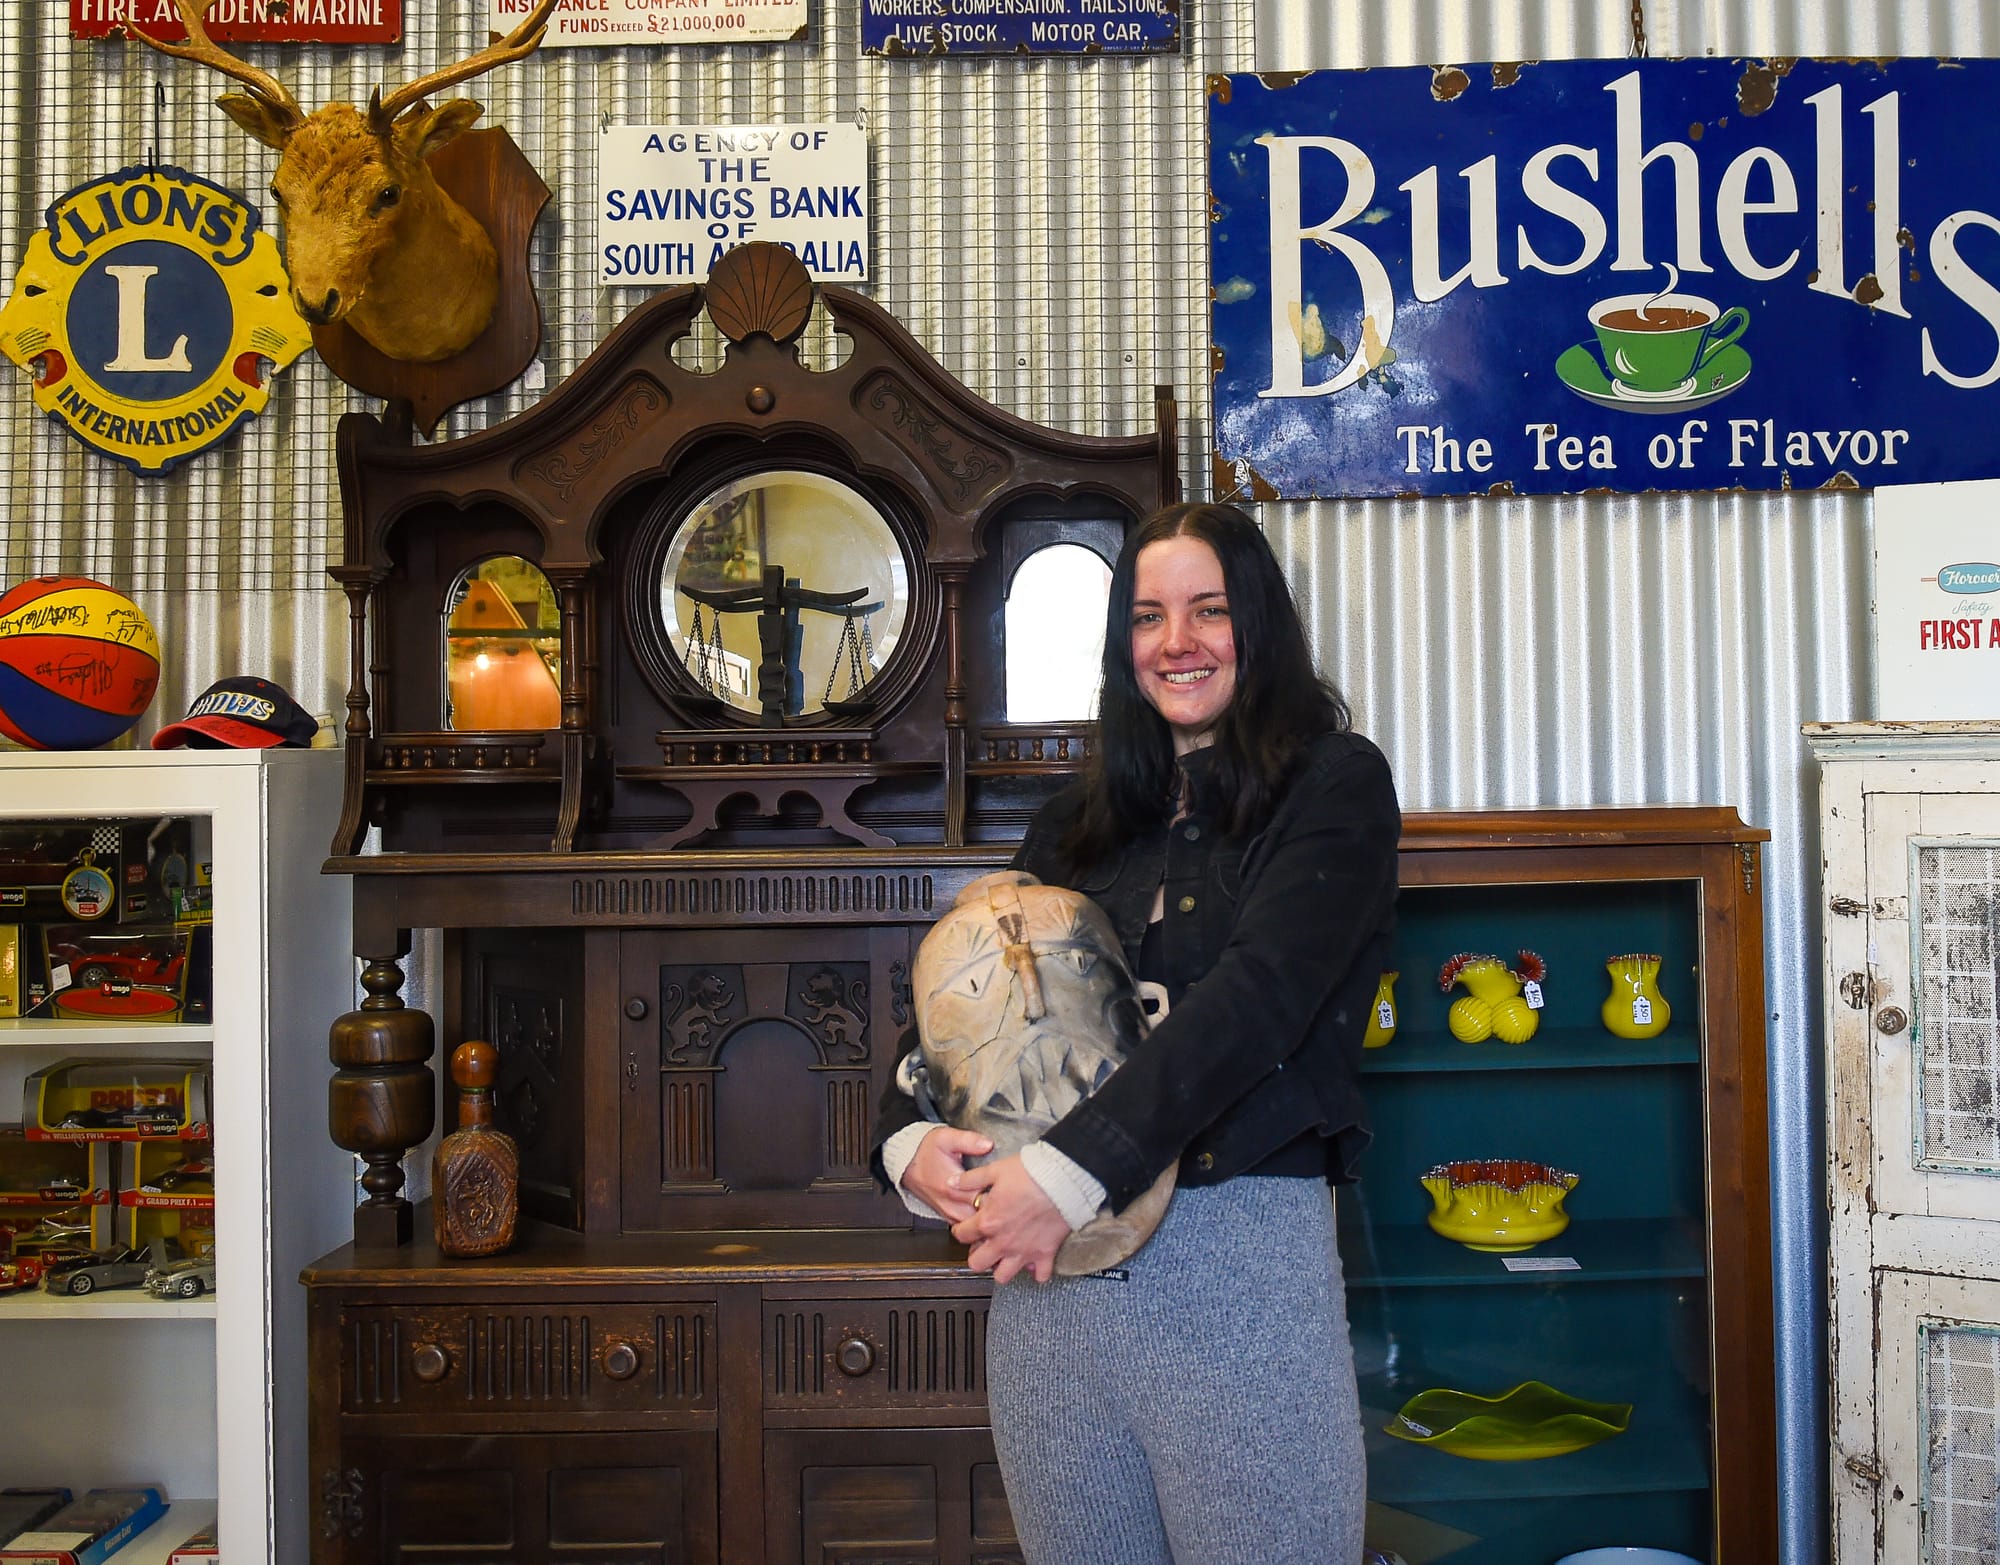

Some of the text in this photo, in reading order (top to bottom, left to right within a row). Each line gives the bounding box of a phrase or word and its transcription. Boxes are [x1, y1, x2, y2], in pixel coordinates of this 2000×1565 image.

[82, 0, 149, 23] FIRE,
[293, 0, 384, 25] MARINE
[498, 0, 609, 13] INSANCE
[560, 18, 609, 33] FUNDS
[611, 23, 643, 32] EXCEED
[896, 23, 934, 43] LIVE
[1032, 21, 1096, 42] MOTOR
[1103, 20, 1149, 41] CAR.
[642, 131, 829, 153] AGENCY OF
[698, 158, 771, 182] THE
[64, 184, 238, 248] LIONS
[606, 186, 864, 221] SAVINGS BANK
[707, 222, 757, 239] OF
[1255, 71, 2000, 398] Bushells
[604, 239, 865, 277] SOUTH AALIA
[104, 265, 192, 372] L
[57, 384, 246, 446] INTERNATIONAL
[1396, 419, 1910, 474] The Tea of Flavor
[1920, 619, 1984, 650] FIRST
